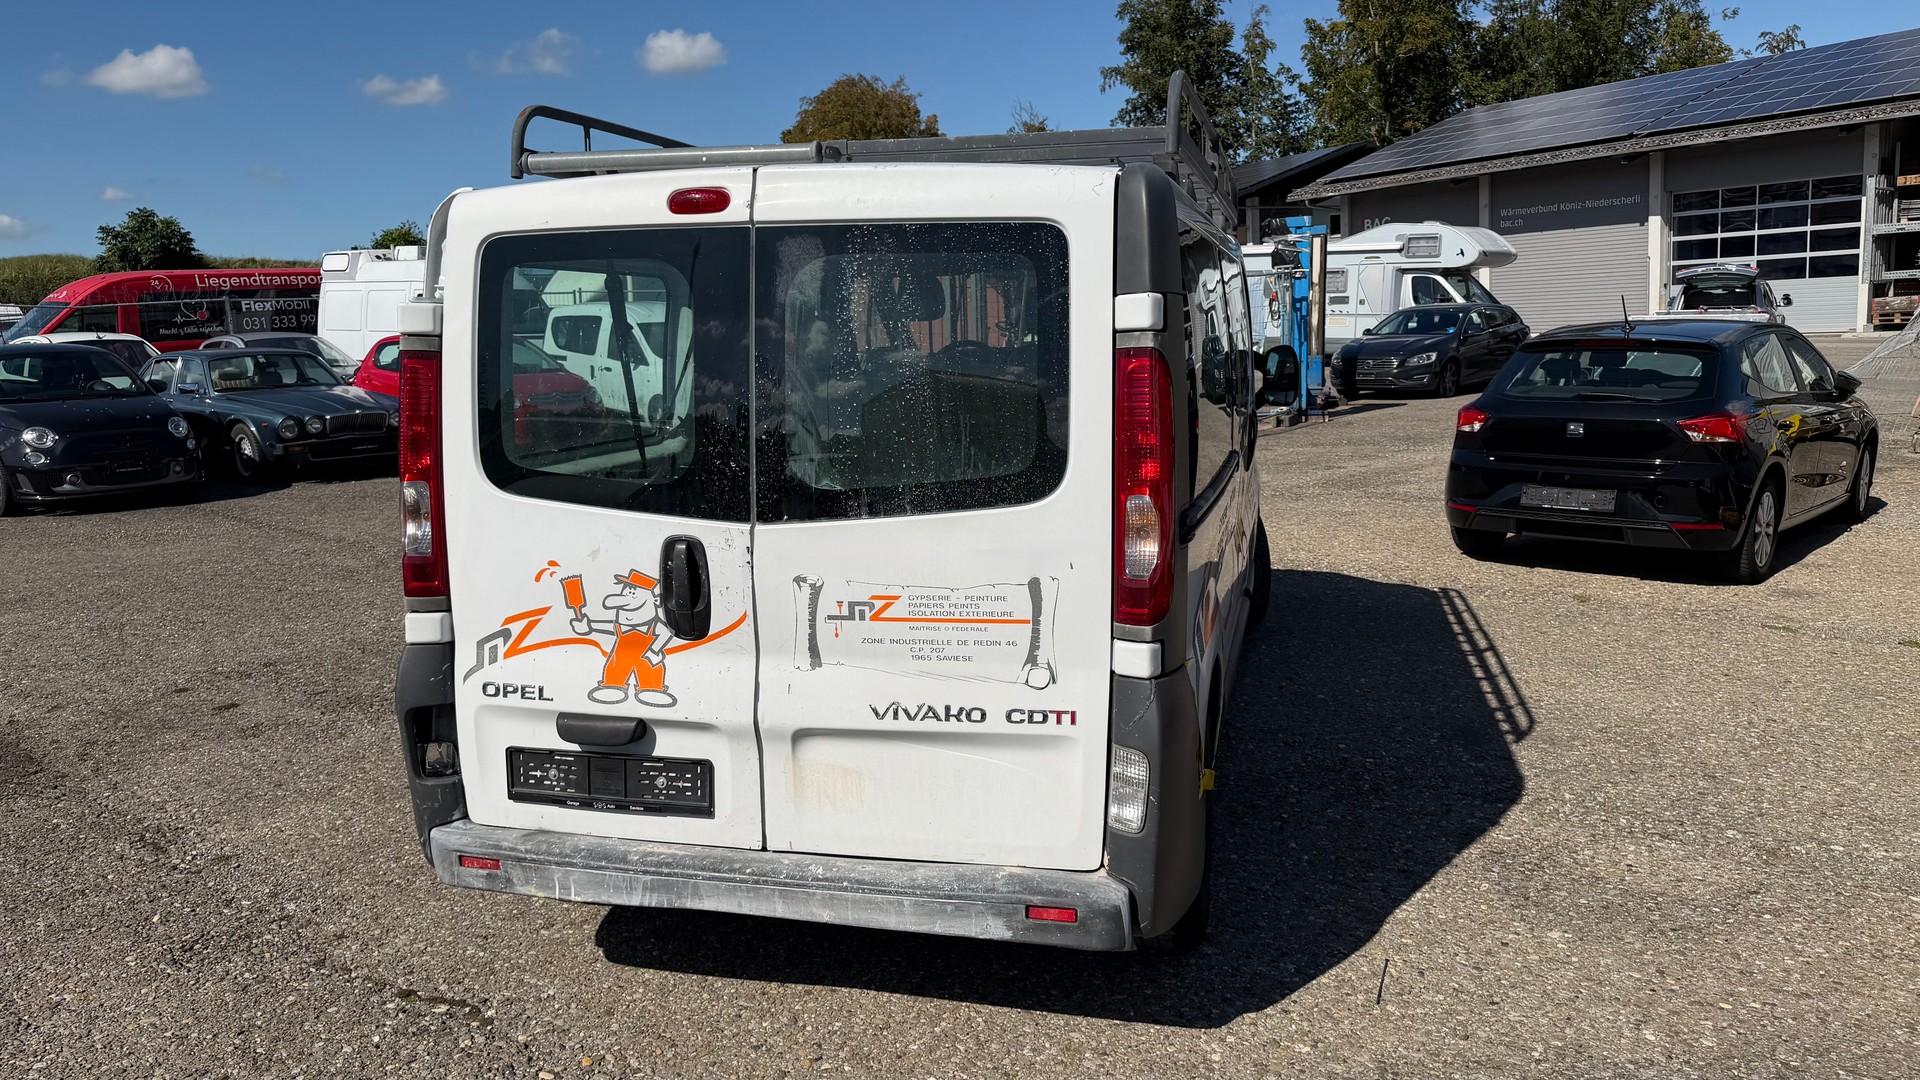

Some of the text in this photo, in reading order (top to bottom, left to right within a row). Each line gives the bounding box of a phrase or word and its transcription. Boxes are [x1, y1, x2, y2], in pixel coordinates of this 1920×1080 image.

[1500, 194, 1641, 217] Wärmeverbund Köniz-Niederscherli
[1500, 218, 1524, 228] bac.ch
[241, 299, 310, 312] FlexMobil
[243, 316, 267, 330] 031
[271, 315, 297, 328] 333
[908, 594, 952, 602] GYPSERIE
[948, 602, 980, 610] PEINTS
[959, 610, 1015, 618] EXTERIEURE
[861, 637, 886, 645] ZONE
[889, 638, 952, 646] INDUSTRIELLE
[973, 639, 1001, 647] REDIN
[481, 680, 554, 702] OPEL
[1005, 708, 1077, 726] CDTI
